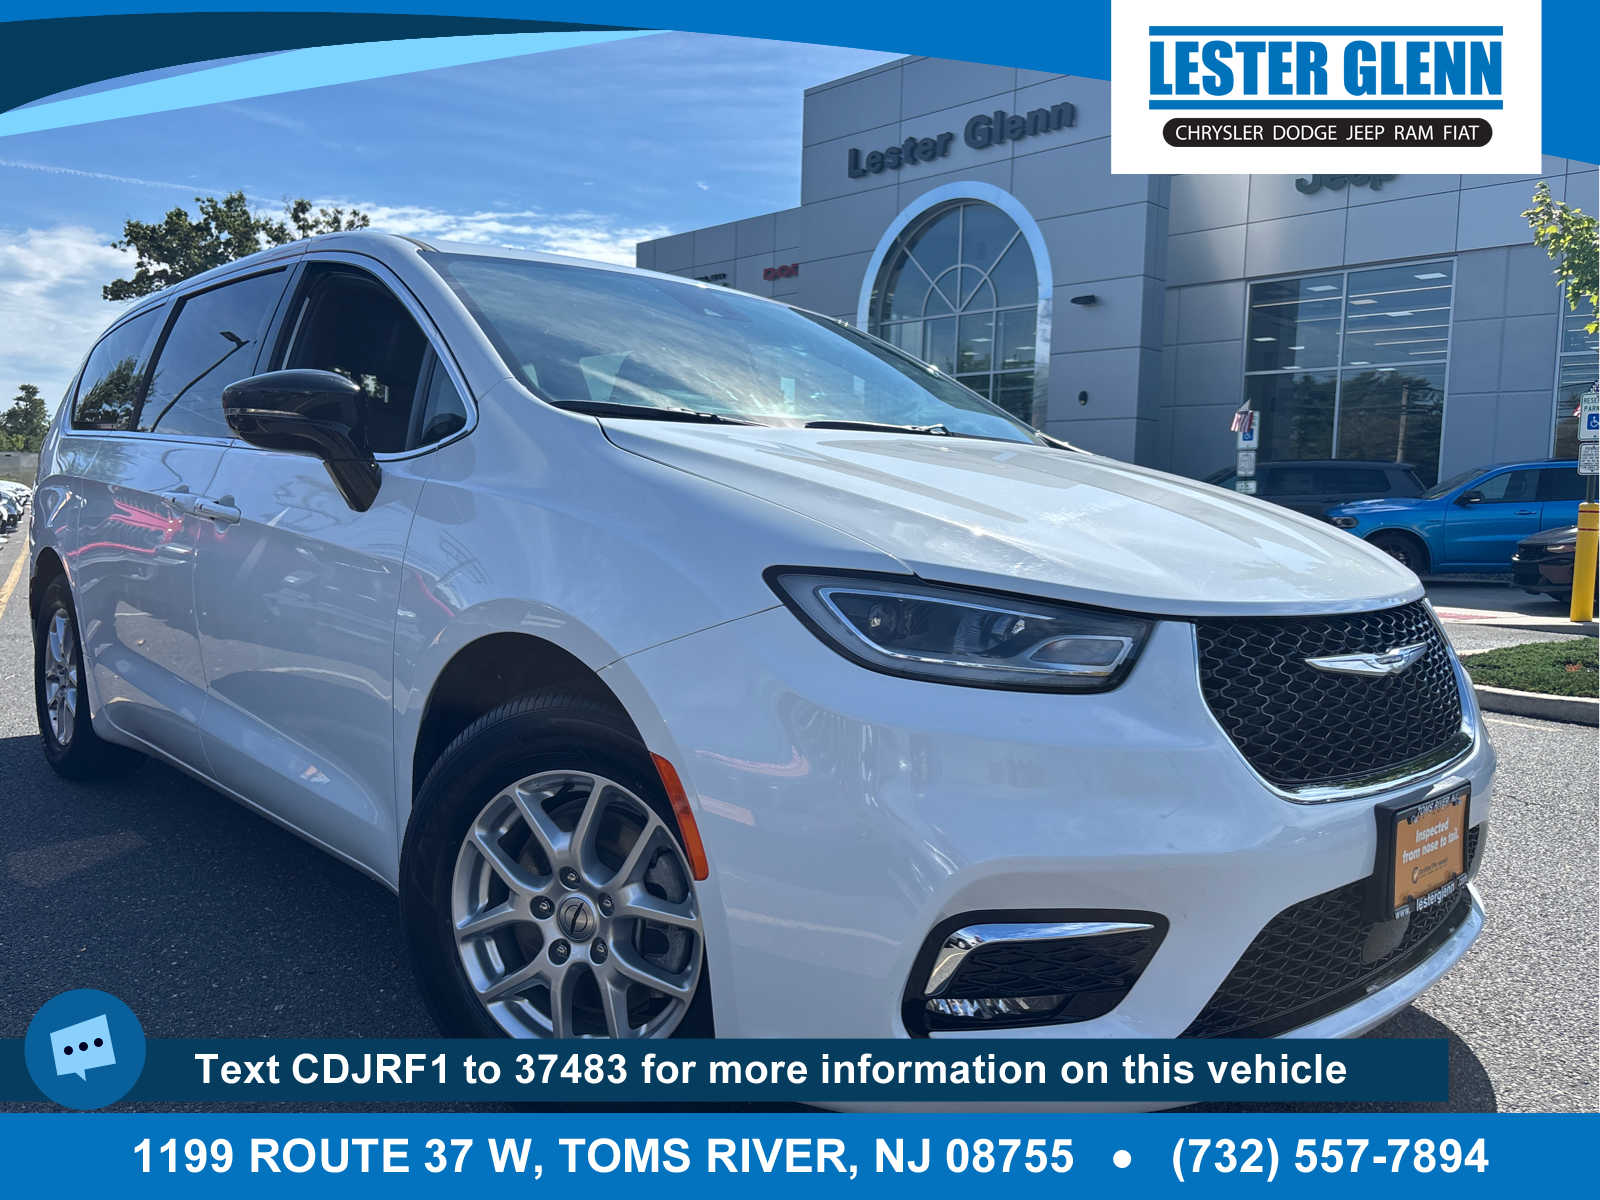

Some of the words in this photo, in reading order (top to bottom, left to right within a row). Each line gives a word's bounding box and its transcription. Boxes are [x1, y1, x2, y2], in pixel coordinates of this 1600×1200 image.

[848, 131, 954, 179] Lester
[963, 101, 1077, 150] Glenn
[1416, 882, 1455, 912] lesterglenn
